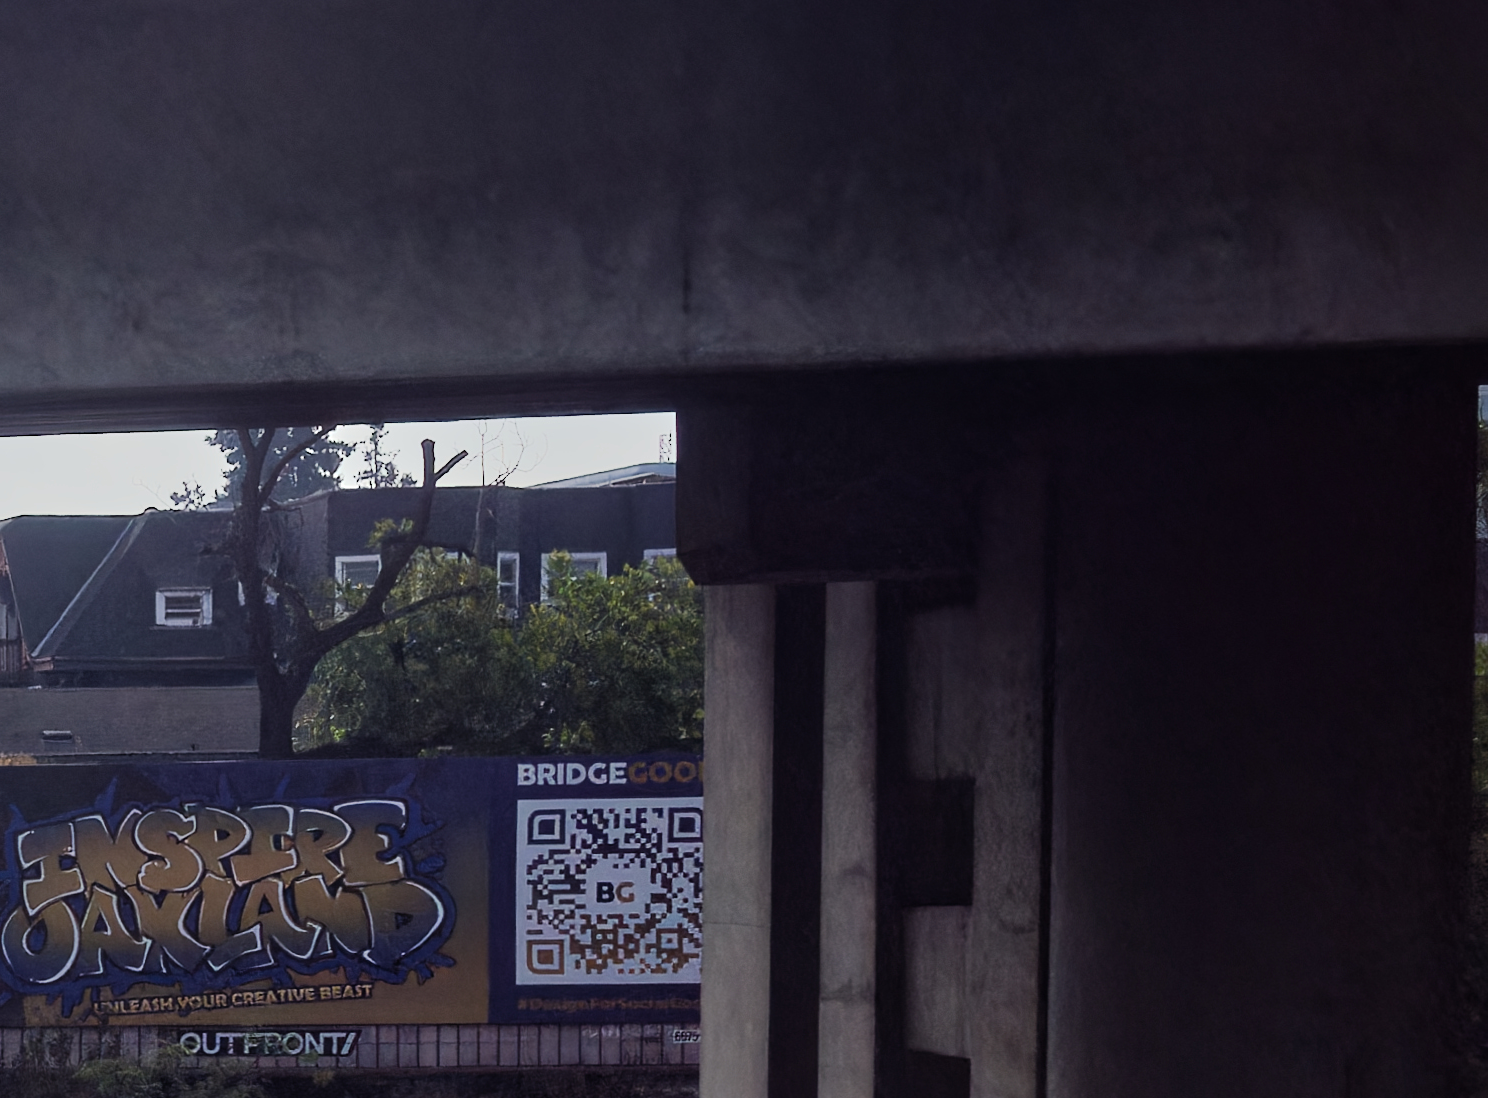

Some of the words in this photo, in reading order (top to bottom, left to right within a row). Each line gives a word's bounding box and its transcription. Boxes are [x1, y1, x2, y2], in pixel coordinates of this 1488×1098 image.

[17, 799, 408, 916] INSPIRE
[596, 881, 635, 903] BG
[0, 874, 446, 985] OAKLAND
[93, 996, 173, 1014] UNLEASH
[178, 993, 228, 1011] YOUR
[231, 987, 316, 1006] CREATIVE
[319, 984, 374, 1000] BEAST
